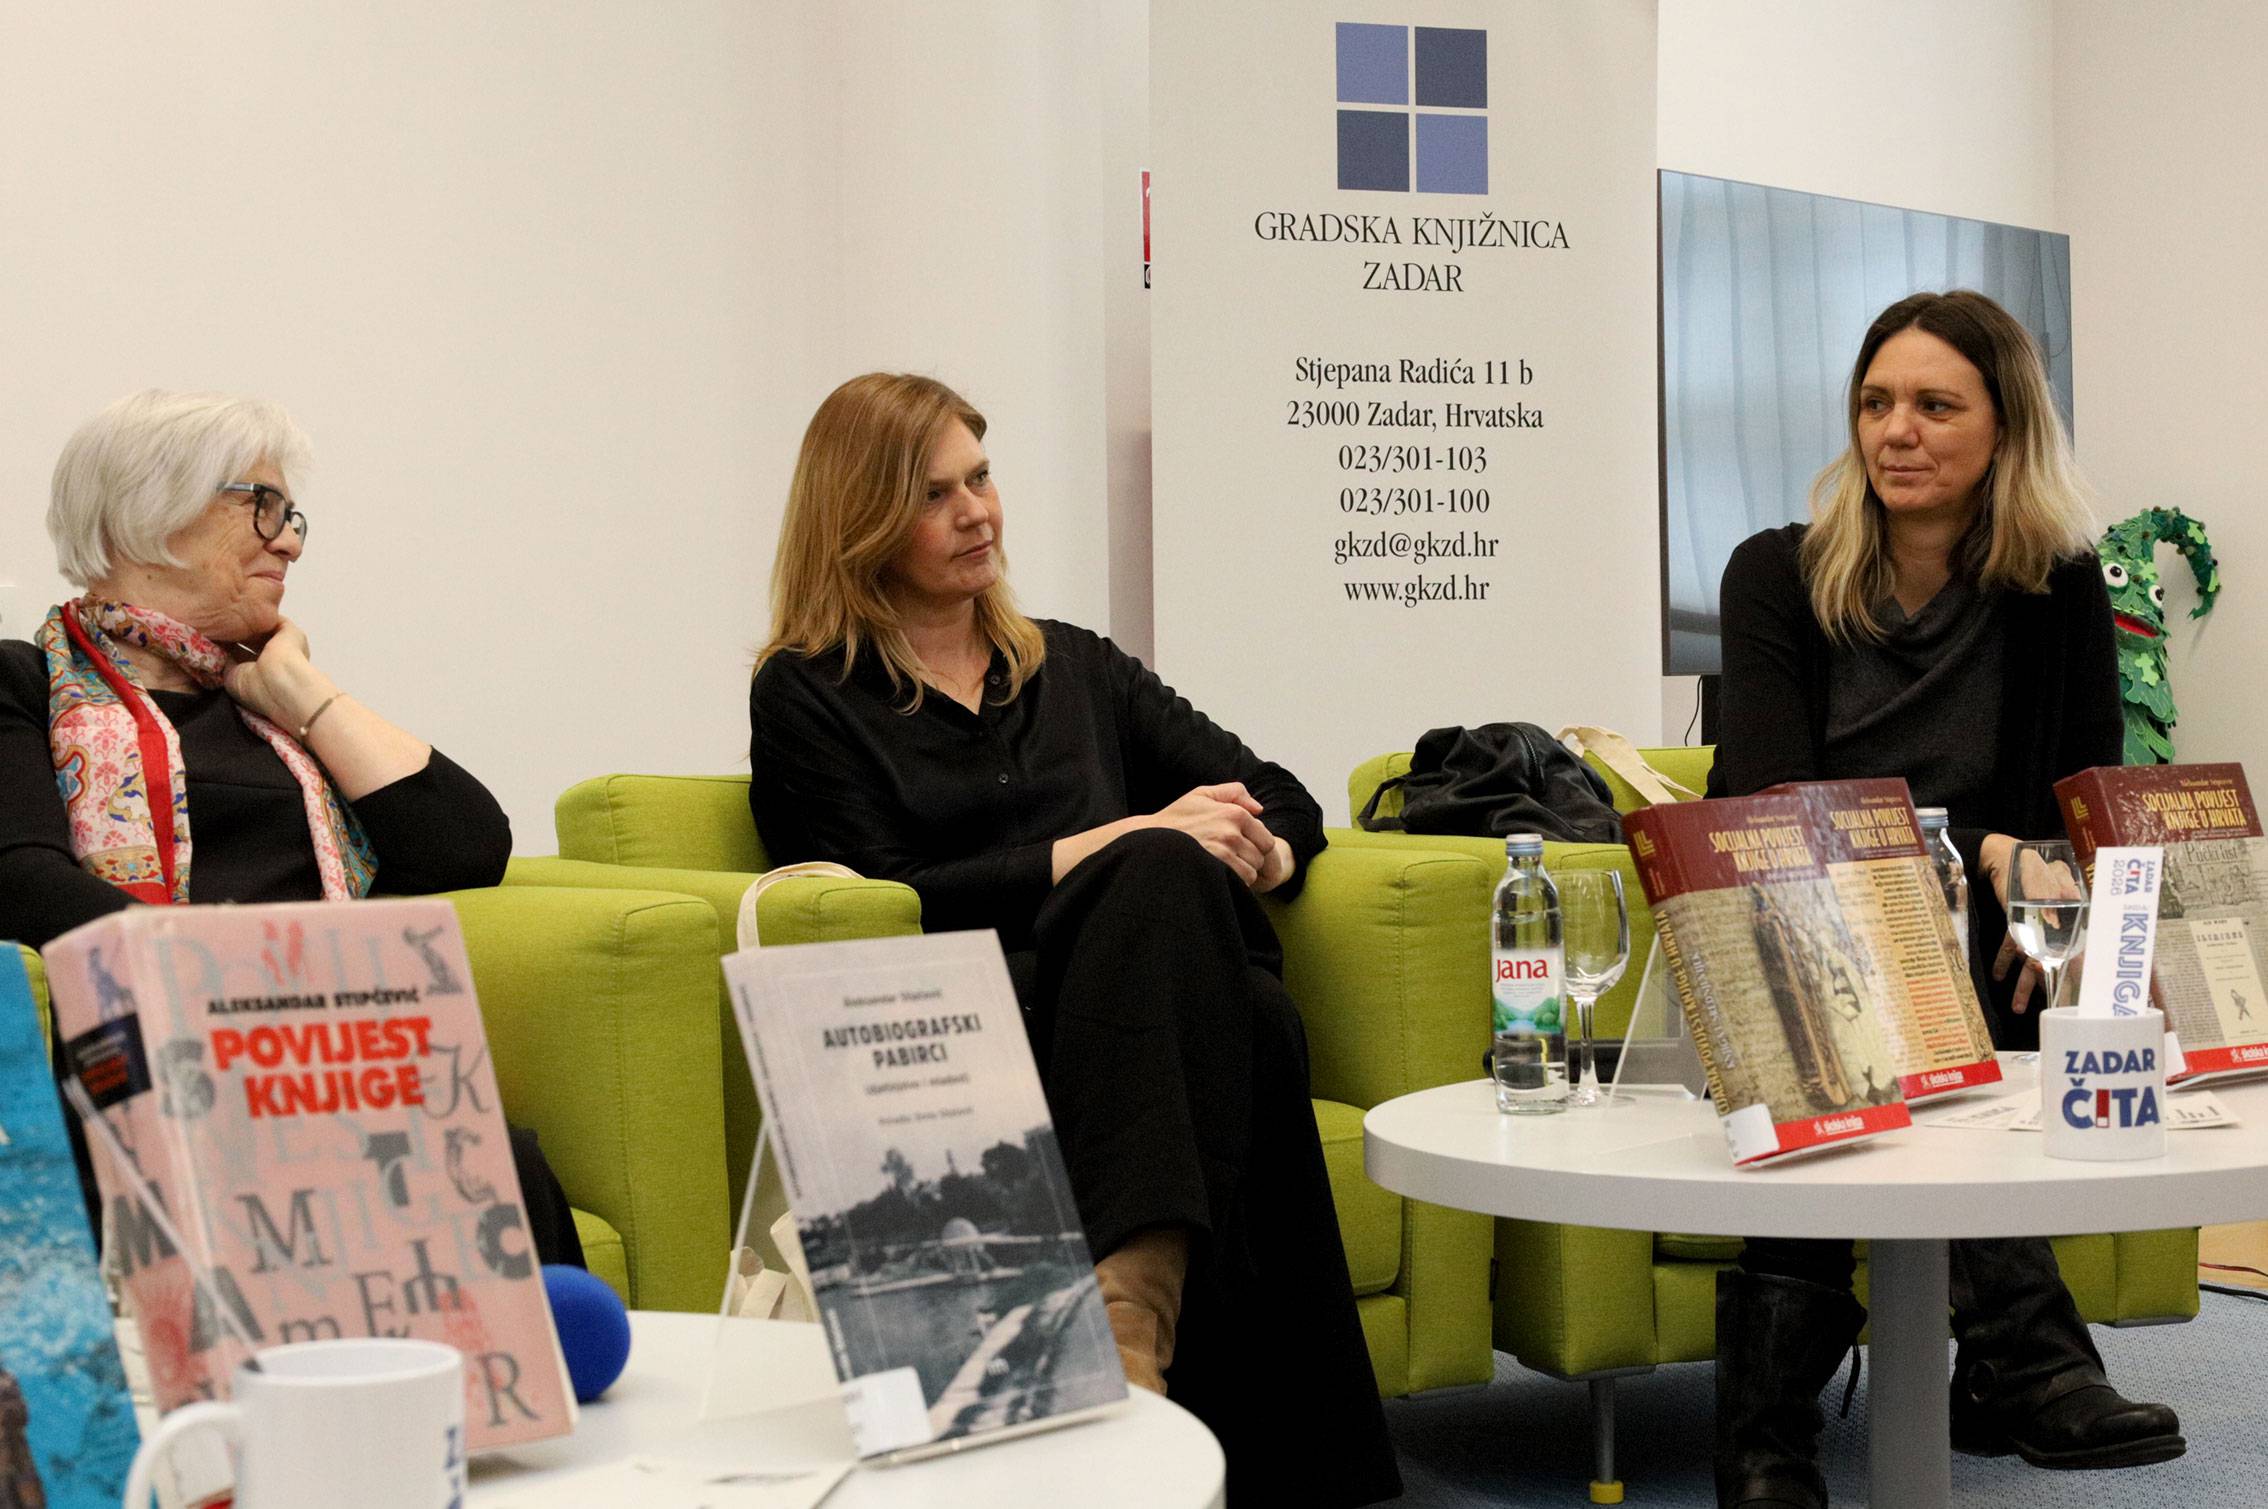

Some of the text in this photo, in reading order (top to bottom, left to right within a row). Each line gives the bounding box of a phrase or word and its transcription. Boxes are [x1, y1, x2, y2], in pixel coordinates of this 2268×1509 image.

[1254, 211, 1570, 254] GRADSKA KNJIŽNICA
[1362, 262, 1464, 292] ZADAR
[1295, 356, 1533, 389] Stjepana Radića 11 b
[1286, 400, 1544, 432] 23000 Zadar, Hrvatska
[1338, 445, 1487, 473] 023/301-103
[1340, 488, 1490, 515] 023/301-100
[1334, 531, 1499, 565] gkzd@gkzd.hr
[1344, 575, 1490, 608] www.gkzd.hr
[2142, 789, 2239, 812] SOCIJALNA POVIJEST
[2164, 807, 2247, 830] KNJIGE U HRVATA
[208, 995, 326, 1015] ALEKSANDAR
[211, 1016, 432, 1071] POVIJEST
[823, 1013, 983, 1048] AUTOBIOGRAFSKI
[873, 1043, 948, 1070] PABIRCI
[2065, 1048, 2156, 1075] ZADAR
[244, 1064, 425, 1118] KNJIGE
[2062, 1078, 2161, 1129] ČITA
